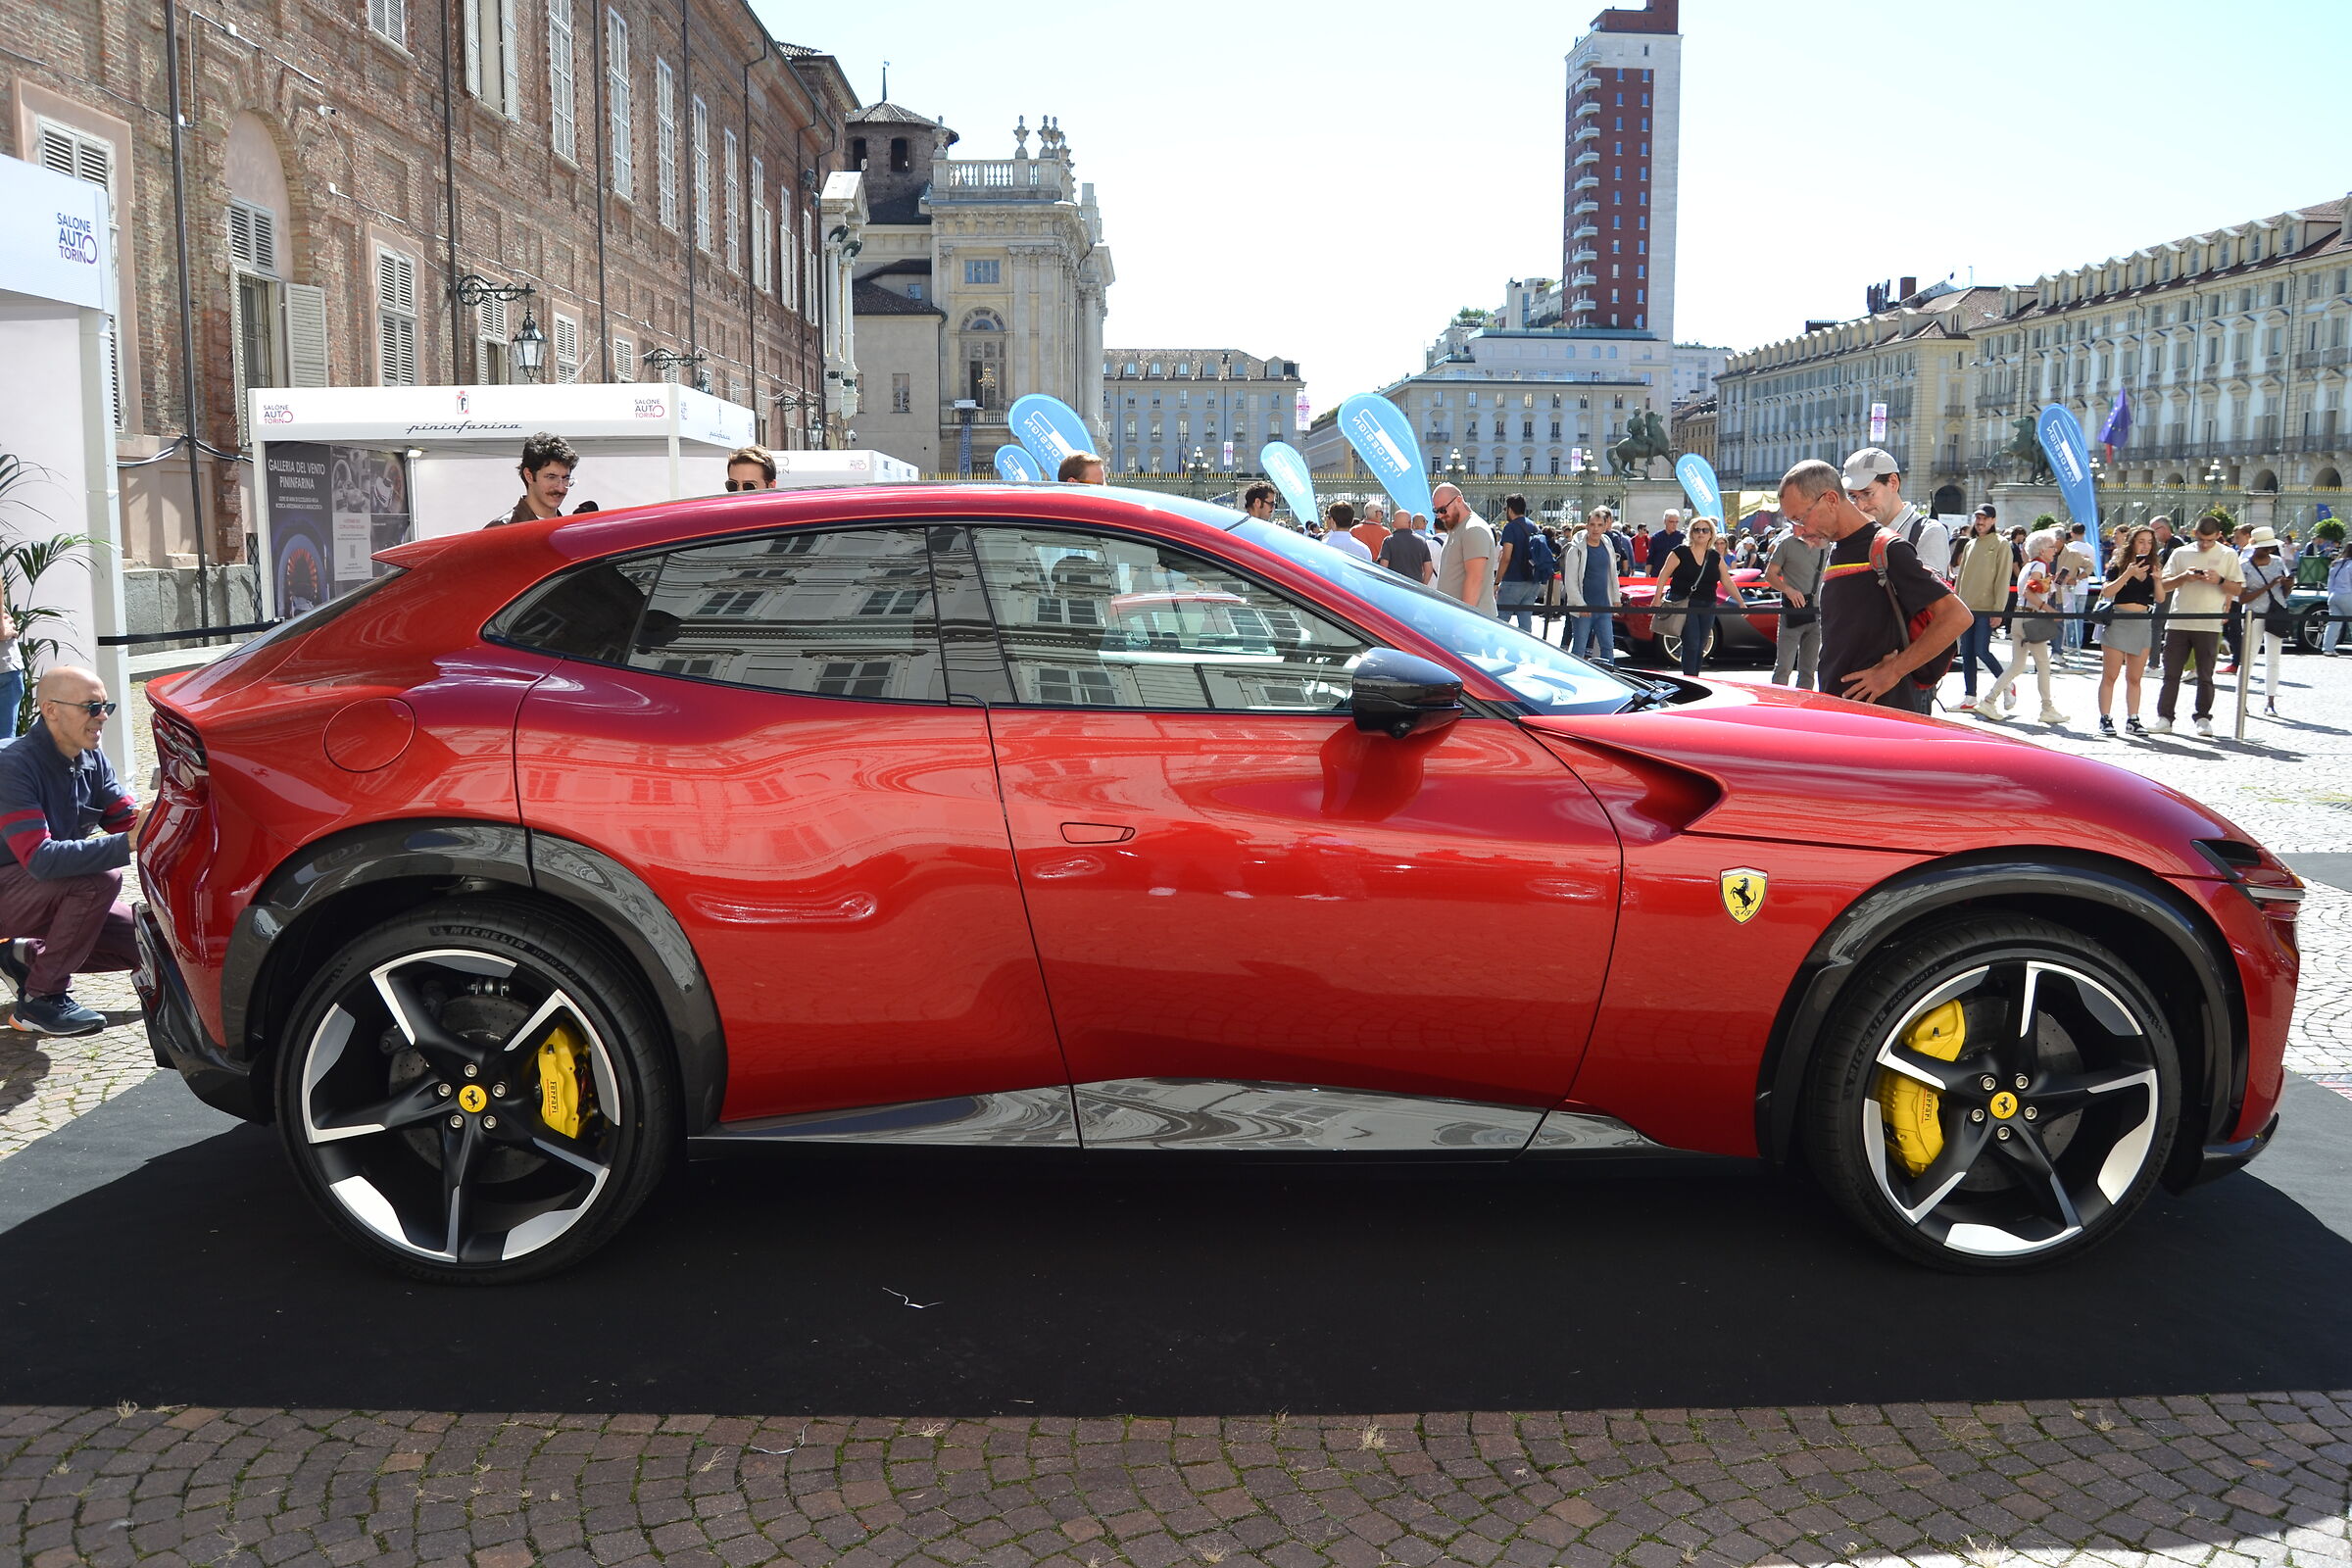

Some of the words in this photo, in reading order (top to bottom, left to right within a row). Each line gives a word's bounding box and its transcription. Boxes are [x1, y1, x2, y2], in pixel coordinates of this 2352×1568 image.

[57, 212, 91, 233] SALONE
[59, 227, 97, 263] AUTO
[264, 411, 293, 421] AUTO
[635, 405, 664, 416] AUTO
[406, 420, 522, 434] pininfarina
[268, 459, 295, 472] GALLERIA
[296, 462, 307, 473] DEL
[307, 462, 325, 475] VENTO
[279, 475, 316, 490] PININFARINA
[450, 926, 527, 949] MICHELIN
[1848, 1009, 1886, 1081] MICHELIN
[550, 1081, 559, 1113] Ferrari
